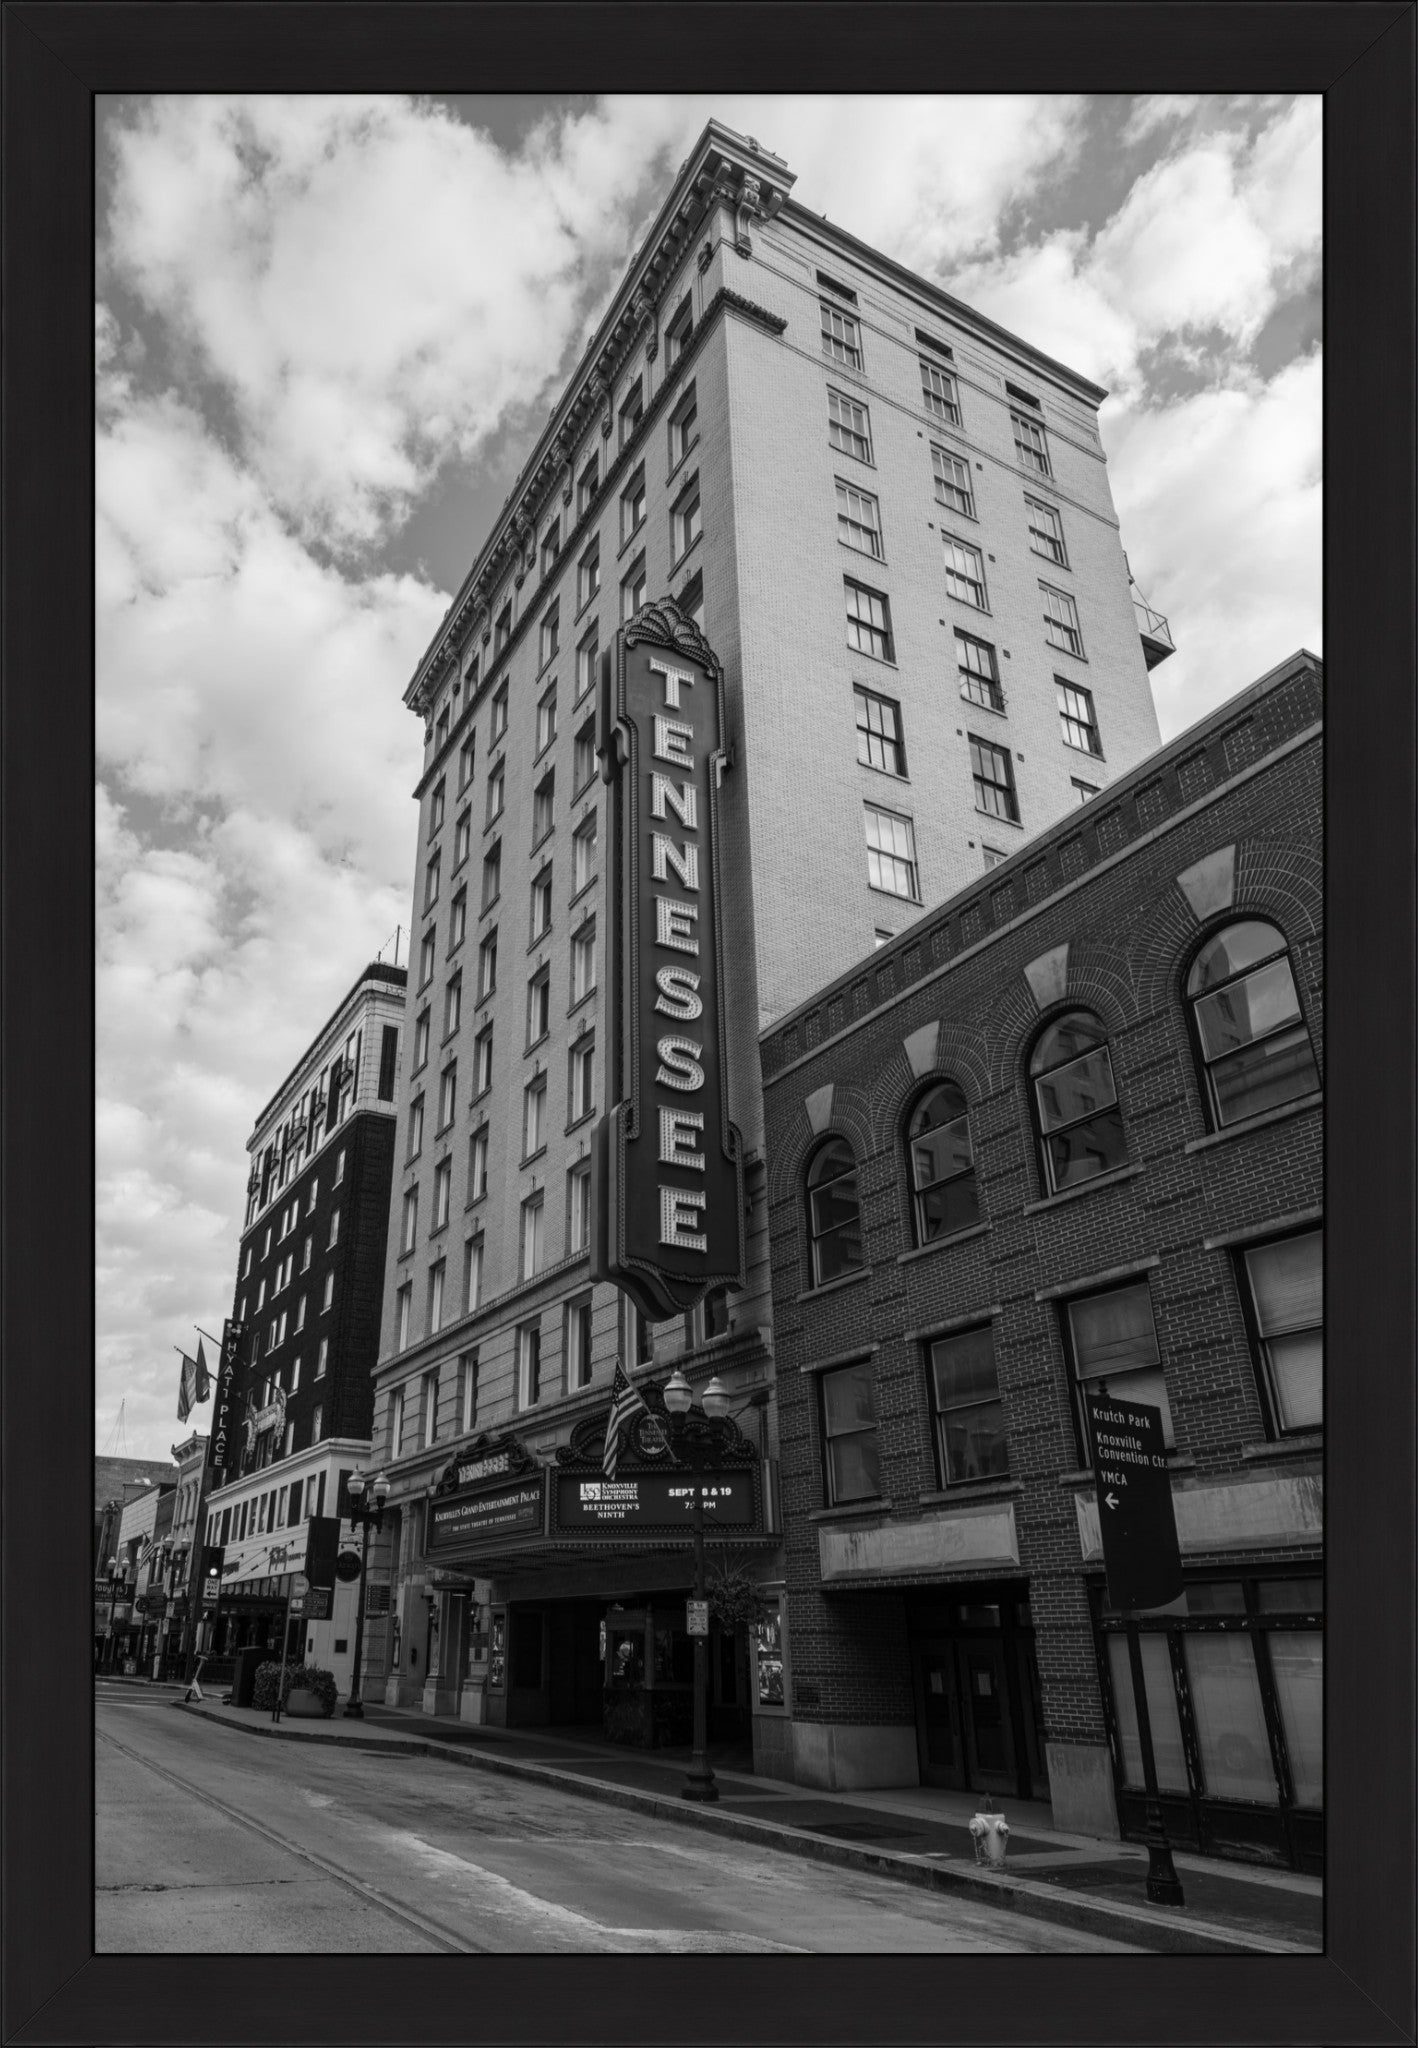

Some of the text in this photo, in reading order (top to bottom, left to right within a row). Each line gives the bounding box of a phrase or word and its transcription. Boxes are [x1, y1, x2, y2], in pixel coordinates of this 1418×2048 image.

[649, 656, 707, 1254] TENNESSEE
[214, 1342, 237, 1466] HYATT PLACE
[1093, 1407, 1150, 1429] Krutch Park
[1096, 1432, 1142, 1450] Knoxville
[1098, 1446, 1149, 1465] Convention
[1101, 1470, 1128, 1486] YMCA
[668, 1487, 695, 1496] SEPT
[711, 1487, 718, 1496] &
[720, 1487, 732, 1496] 19
[461, 1505, 479, 1516] GRAND
[478, 1495, 519, 1512] ENTERTAINMENT
[520, 1490, 540, 1503] PALACE
[583, 1503, 640, 1511] BEETHOVEN'S
[703, 1501, 716, 1509] PM
